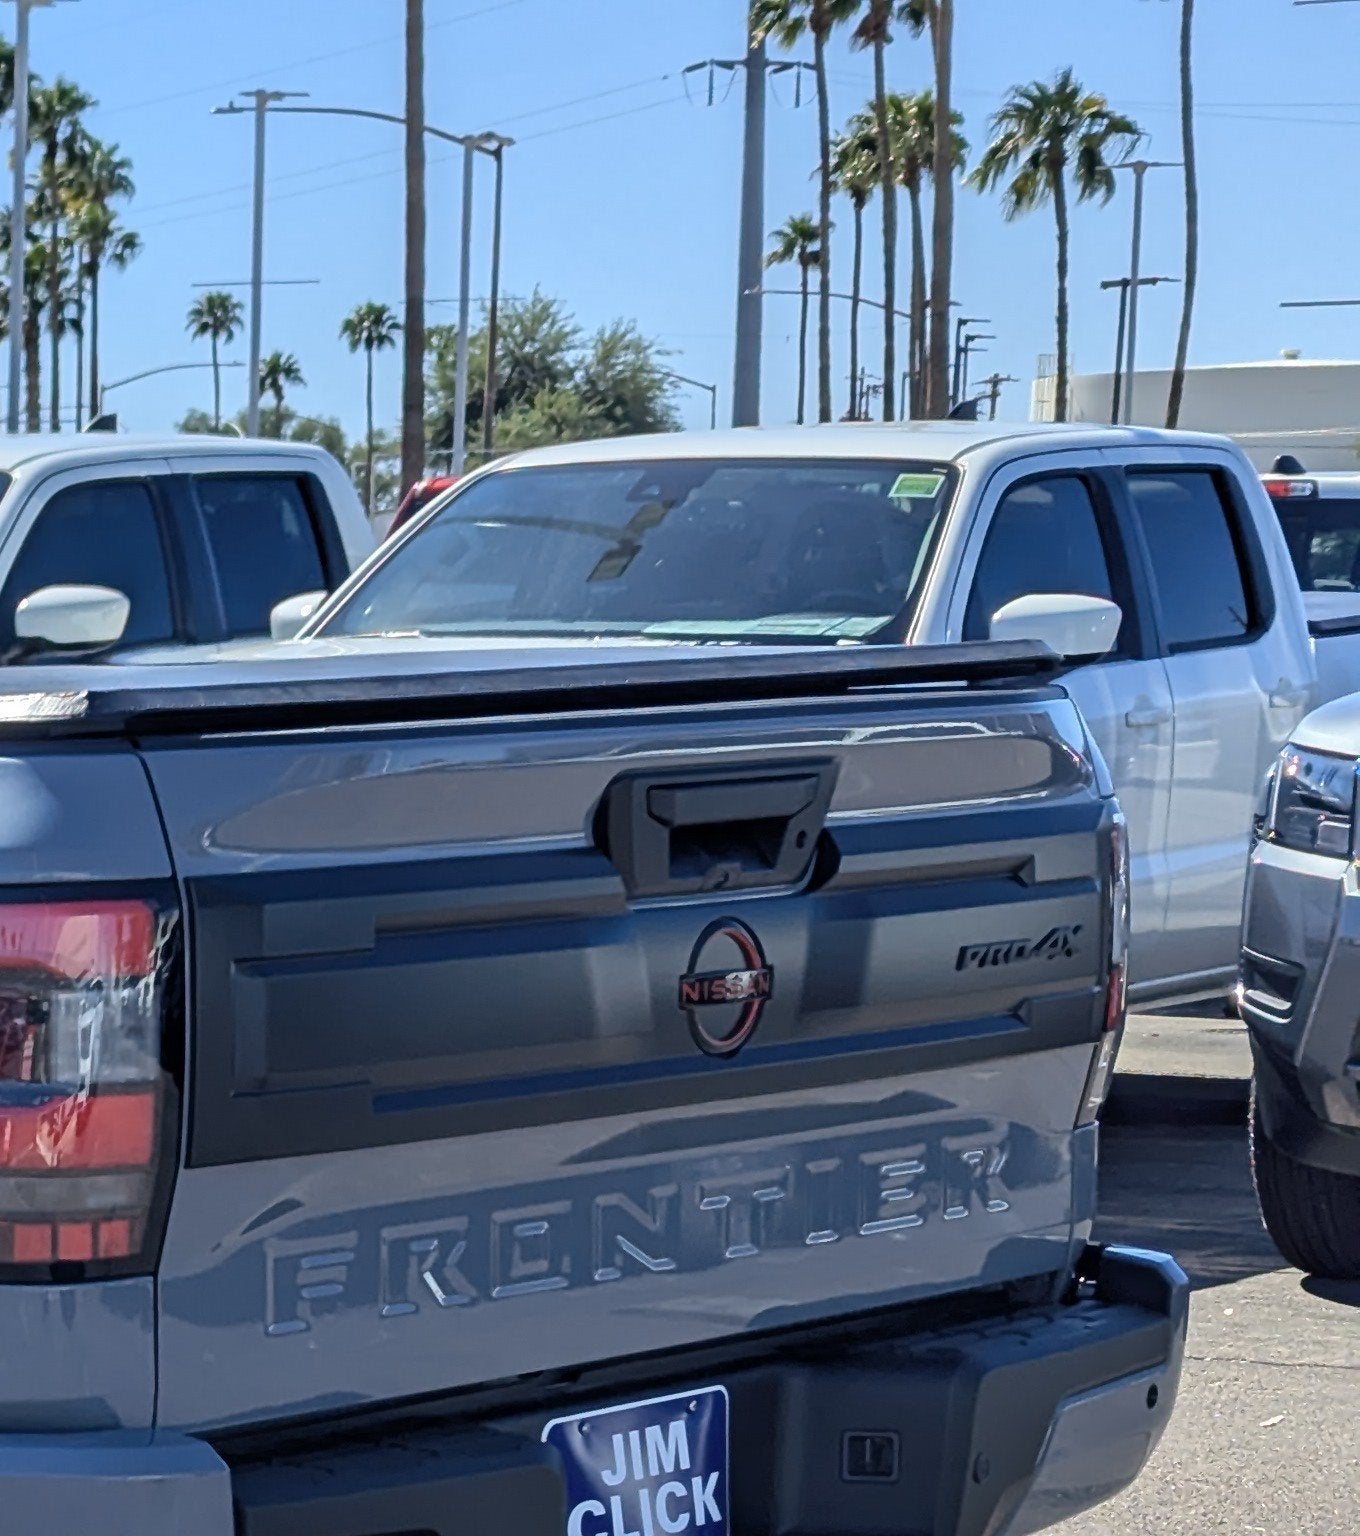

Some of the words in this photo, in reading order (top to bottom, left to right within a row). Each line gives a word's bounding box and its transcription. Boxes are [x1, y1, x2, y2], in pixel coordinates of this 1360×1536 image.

[681, 971, 771, 1002] NISSAN
[262, 1131, 1012, 1336] FRONTIER
[601, 1419, 691, 1487] JIM
